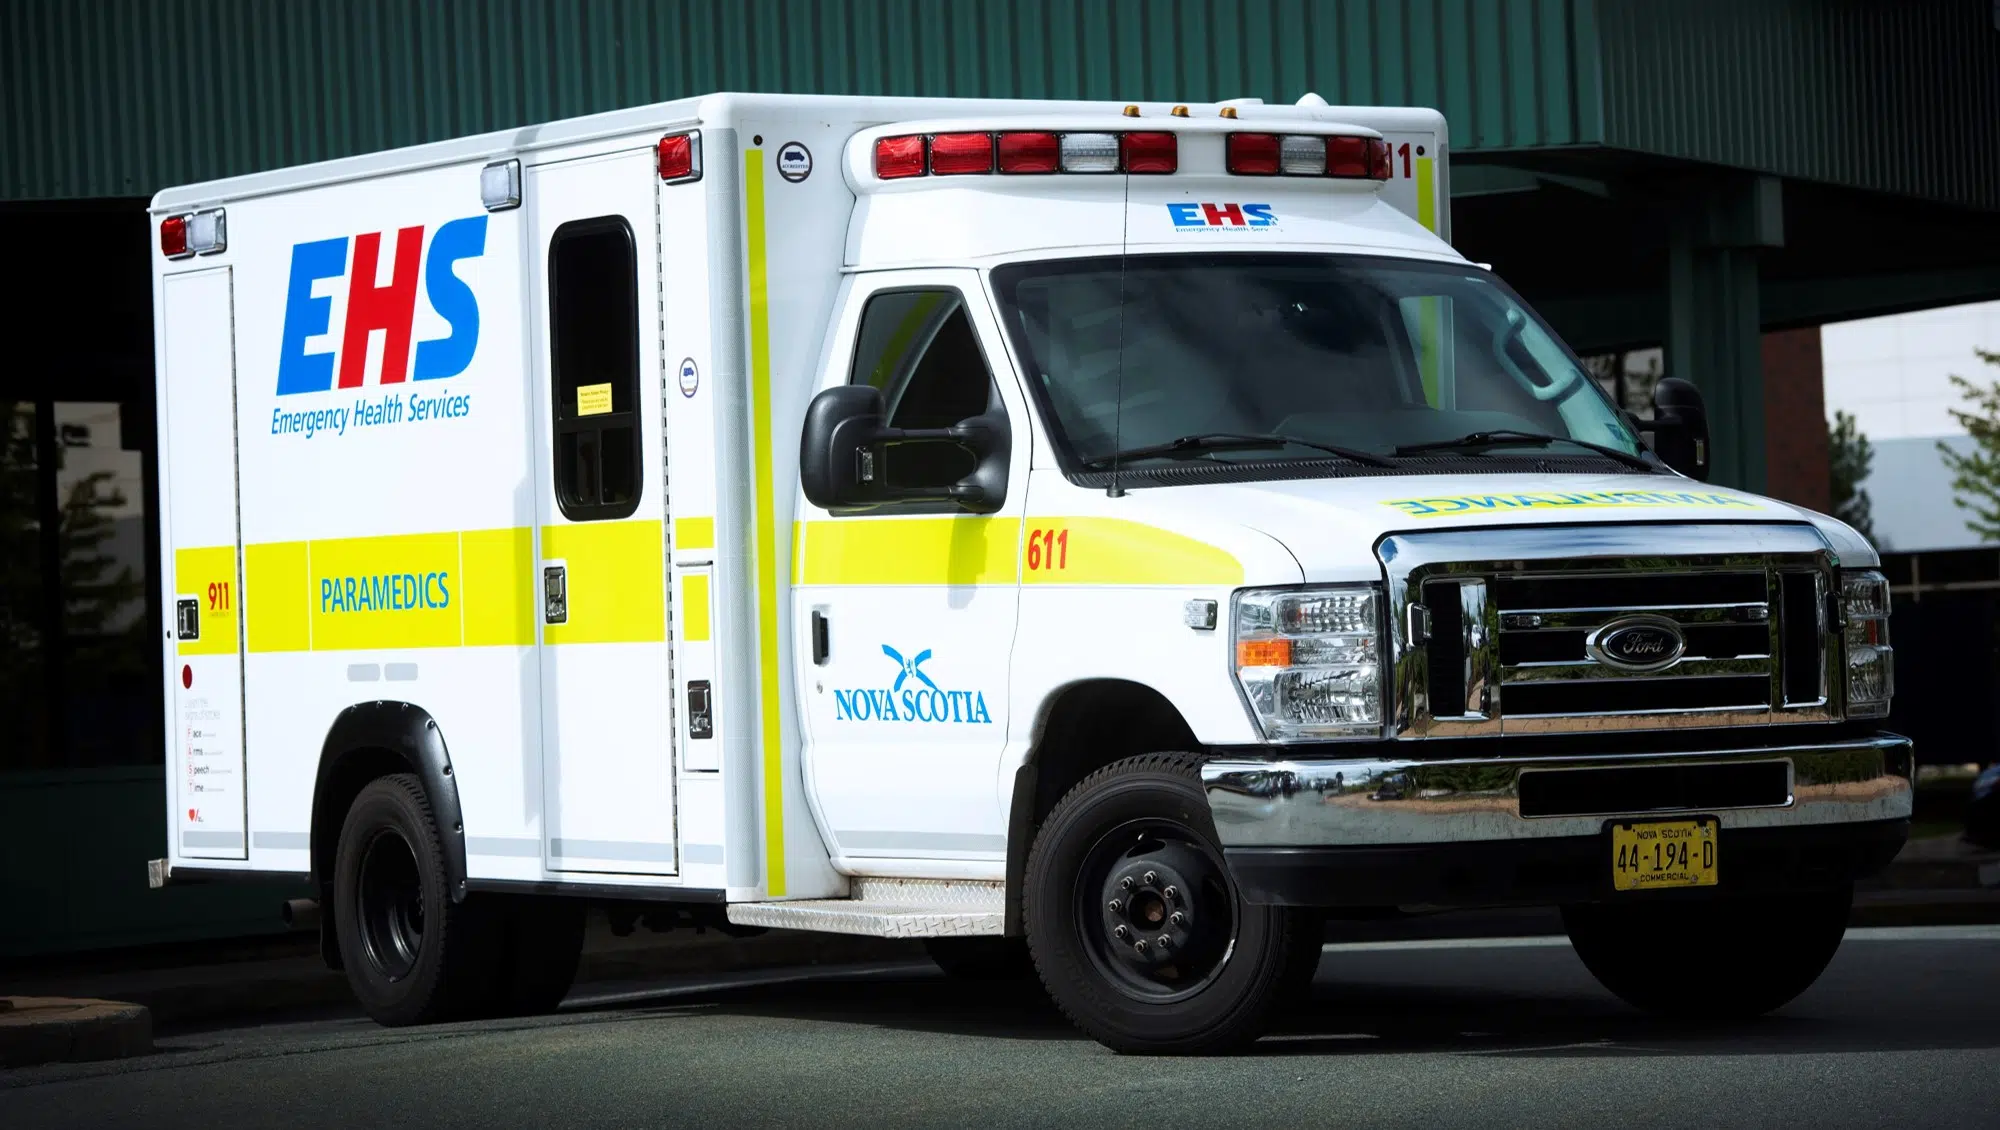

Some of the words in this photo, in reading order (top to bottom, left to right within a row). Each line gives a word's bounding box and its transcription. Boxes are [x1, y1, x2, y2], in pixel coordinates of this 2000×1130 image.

[1166, 203, 1278, 226] EHS
[276, 214, 489, 396] EHS
[271, 407, 350, 439] Emergency
[353, 394, 402, 427] Health
[407, 389, 471, 422] Services
[1028, 529, 1068, 571] 611
[208, 582, 229, 610] 911
[321, 572, 450, 613] PARAMEDICS
[1623, 632, 1664, 655] Ford
[834, 689, 901, 721] NOVA
[902, 689, 992, 724] SCOTIA
[1636, 831, 1658, 840] NOVA
[1661, 828, 1693, 839] SCOTIA
[1617, 840, 1713, 873] 44-194-D
[1640, 872, 1689, 882] COMMERCIAL
